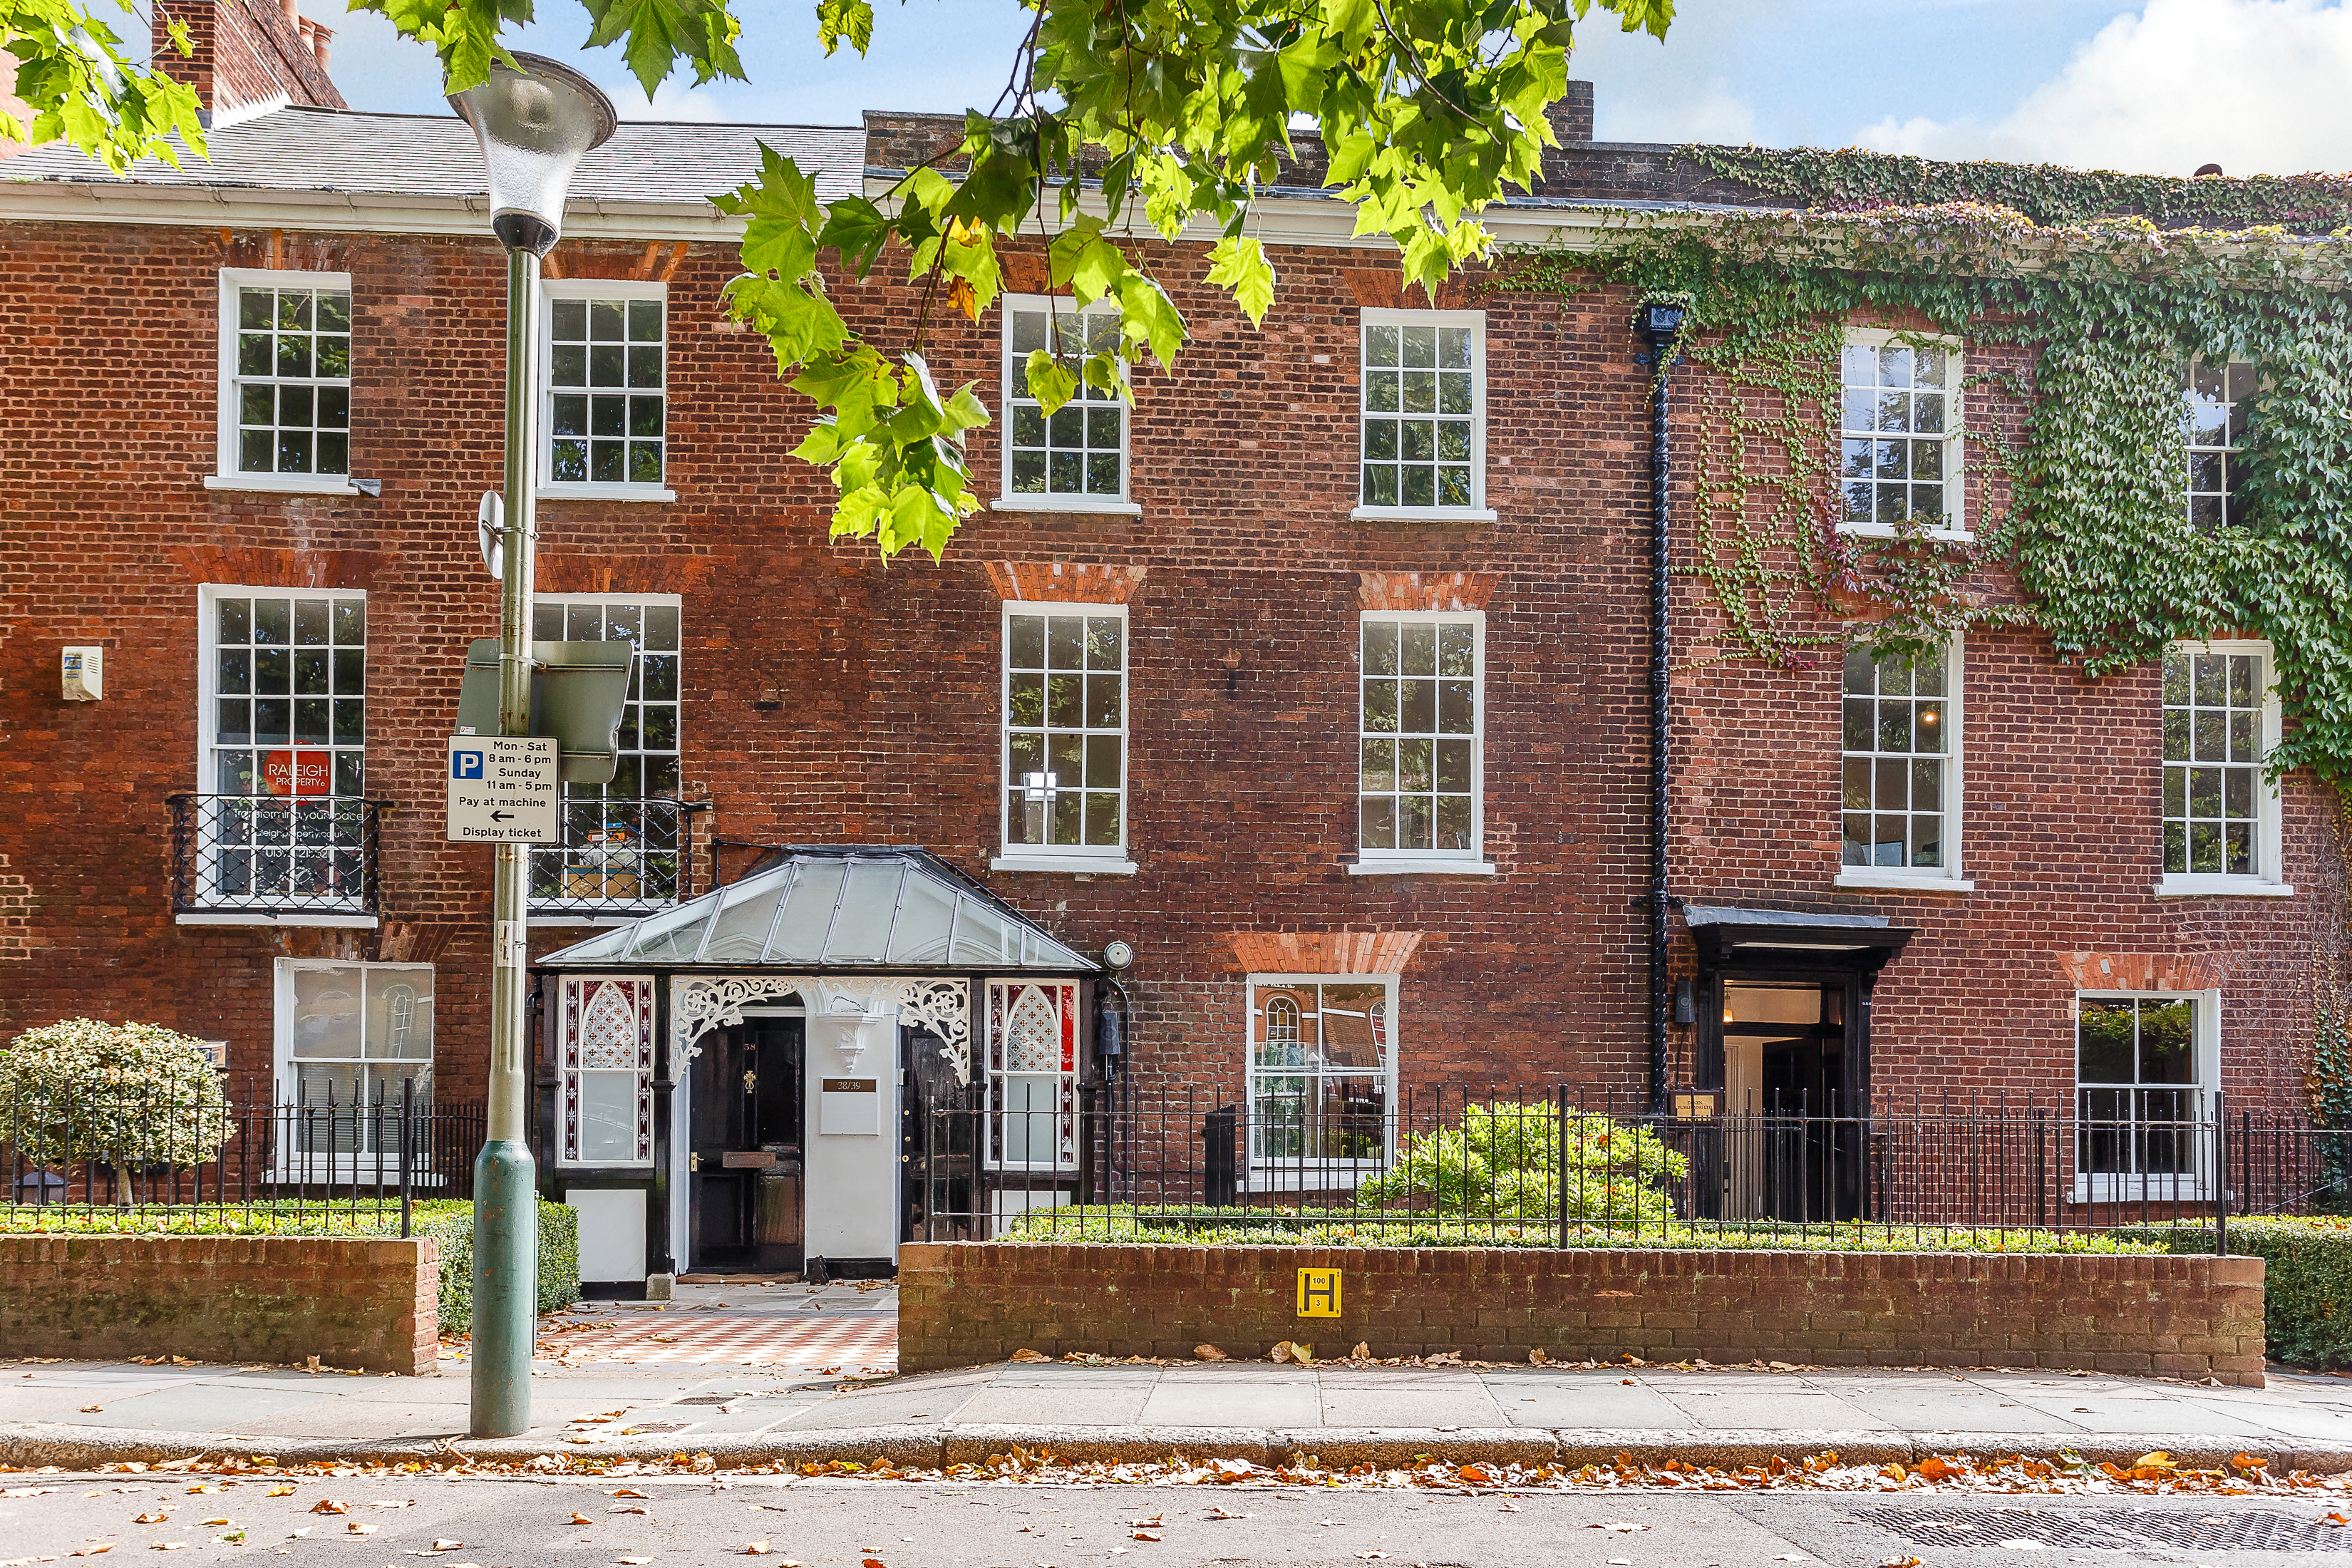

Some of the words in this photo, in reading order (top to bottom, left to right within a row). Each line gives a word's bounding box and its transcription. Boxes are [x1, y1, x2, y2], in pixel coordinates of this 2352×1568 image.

[493, 741, 517, 751] Mon
[527, 742, 547, 751] Sat
[460, 753, 479, 777] P
[488, 754, 496, 763] 8
[524, 755, 532, 763] 6
[534, 756, 552, 765] pm
[269, 763, 328, 777] RALEIGH
[498, 768, 542, 779] Sunday
[276, 777, 321, 786] PROPERTY
[487, 780, 496, 789] 11
[525, 781, 532, 790] 5
[535, 783, 552, 791] pm
[459, 796, 480, 807] Pay
[483, 798, 495, 806] at
[499, 798, 547, 807] machine
[233, 808, 301, 822] Trasforming
[330, 813, 363, 822] pace
[463, 827, 505, 838] Display
[508, 827, 542, 837] ticket
[266, 849, 292, 857] 0139
[837, 1081, 861, 1090] 38/39
[1304, 1273, 1335, 1312] H
